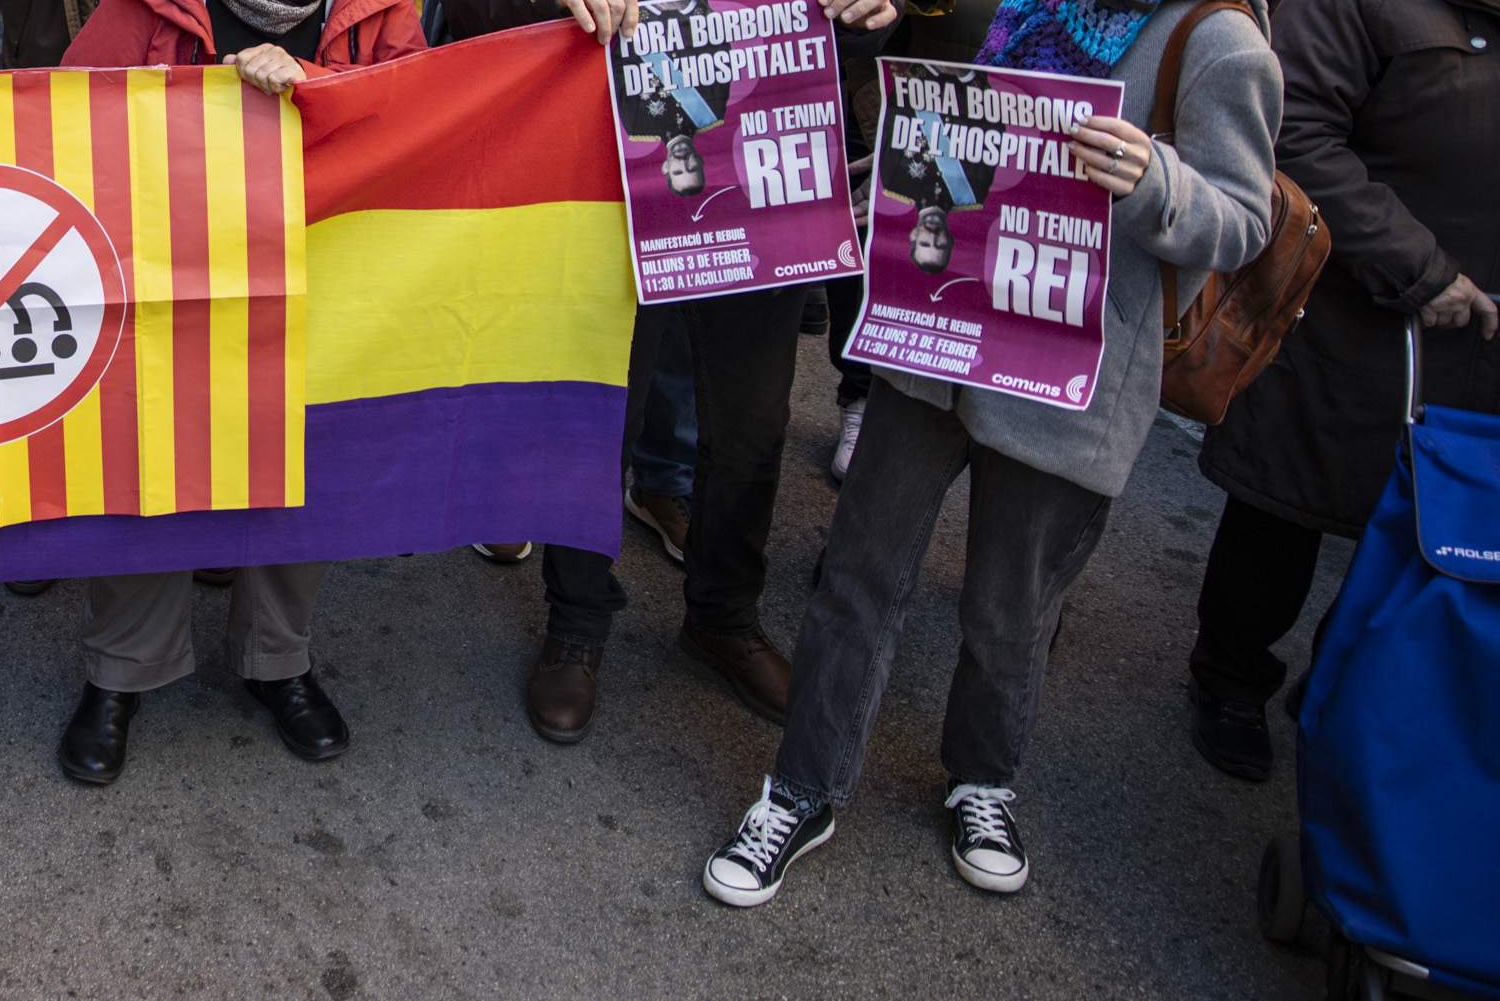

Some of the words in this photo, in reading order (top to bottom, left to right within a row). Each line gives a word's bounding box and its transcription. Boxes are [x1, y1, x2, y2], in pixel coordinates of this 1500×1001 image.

[619, 17, 684, 59] FORA
[689, 0, 809, 48] BORBONS
[623, 62, 657, 96] DE
[661, 36, 827, 92] L'HOSPITALET
[892, 75, 959, 117] FORA
[739, 110, 768, 137] NO
[773, 100, 836, 130] TENIM
[891, 115, 923, 152] DE
[930, 118, 1089, 181] L'HOSPITALE
[743, 131, 833, 210] REI
[640, 230, 702, 253] MANIFESTACIÓ
[703, 231, 714, 244] DE
[715, 228, 745, 243] REBUIG
[1000, 204, 1030, 236] NO
[1037, 210, 1103, 250] TENIM
[641, 256, 685, 276] DILLUNS
[687, 255, 695, 270] 3
[697, 253, 711, 269] DE
[712, 248, 751, 267] FEBRER
[644, 273, 675, 293] 11:30
[677, 273, 686, 288] A
[687, 266, 754, 288] L'ACOLLIDORA
[774, 258, 837, 278] comuns
[992, 235, 1091, 328] REI
[871, 303, 935, 328] MANIFESTACIÓ
[936, 315, 949, 331] DE
[950, 319, 982, 338] REBUIG
[856, 338, 888, 357] 11:30
[888, 342, 897, 357] A
[898, 346, 970, 375] L'ACOLLIDORA
[861, 322, 908, 345] DILLUNS
[909, 330, 918, 347] 3
[919, 333, 934, 350] DE
[936, 337, 978, 360] FEBRER
[991, 372, 1061, 398] comuns
